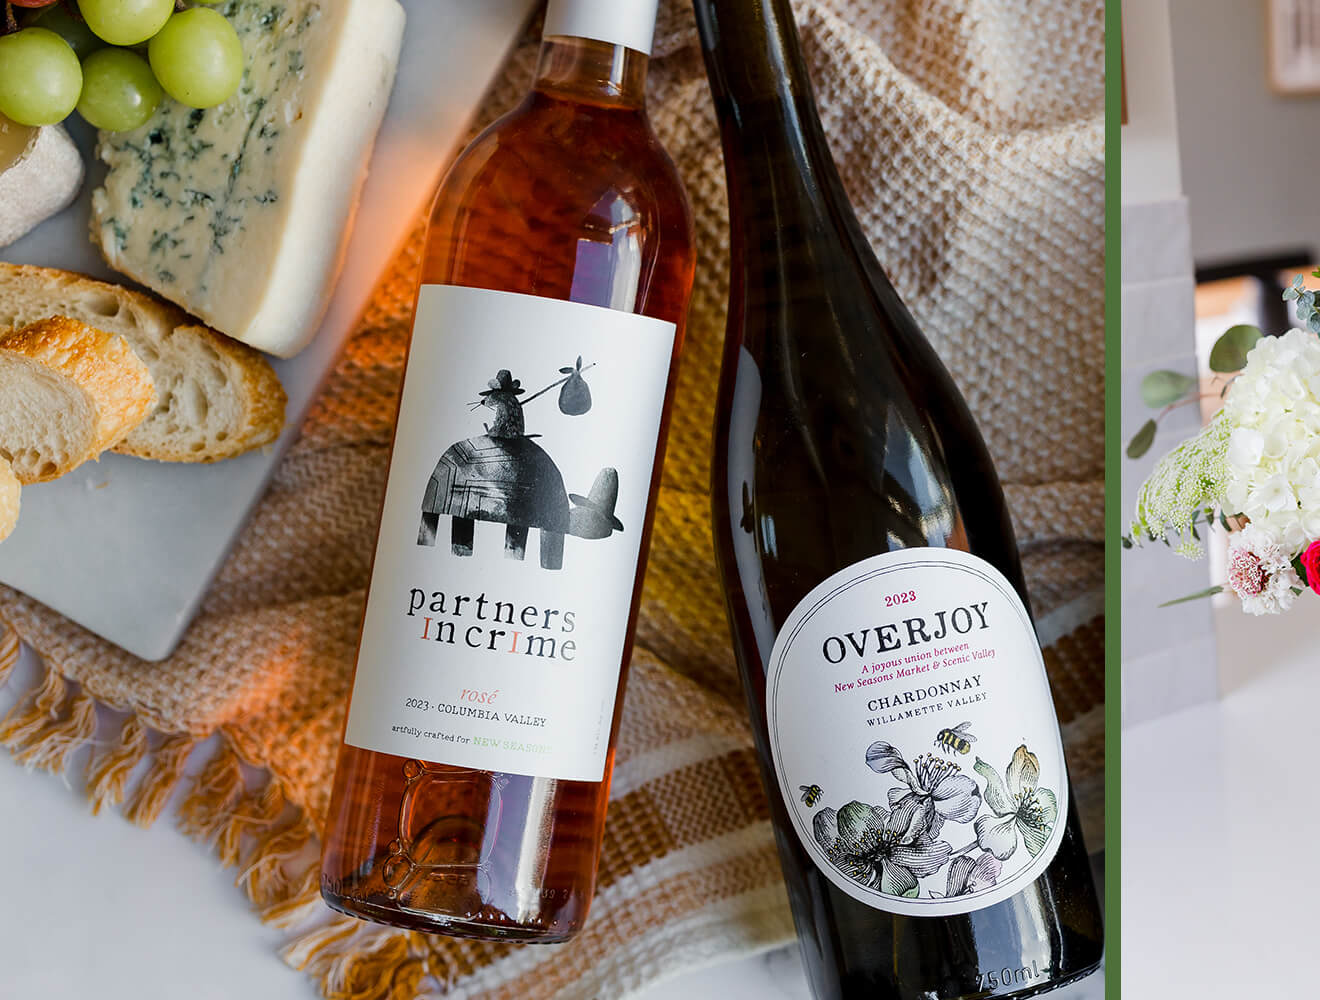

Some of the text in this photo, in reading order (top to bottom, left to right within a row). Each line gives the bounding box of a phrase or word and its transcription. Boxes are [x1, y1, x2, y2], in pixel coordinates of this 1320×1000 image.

[406, 587, 577, 634] partners
[884, 590, 917, 608] 2023
[822, 602, 990, 664] OVERJOY
[834, 648, 997, 693] New Seasons Market & Scenic Valley
[861, 641, 969, 675] A joyous union between
[460, 688, 500, 705] rosé
[866, 691, 988, 727] WILLAMETTE VALLEY
[867, 674, 983, 713] CHARDONNAY
[405, 697, 547, 728] 2023 COLUMBIA VALLEY
[391, 724, 422, 738] artfully
[423, 730, 455, 743] crafted
[456, 735, 470, 744] for
[473, 736, 500, 748] NEW
